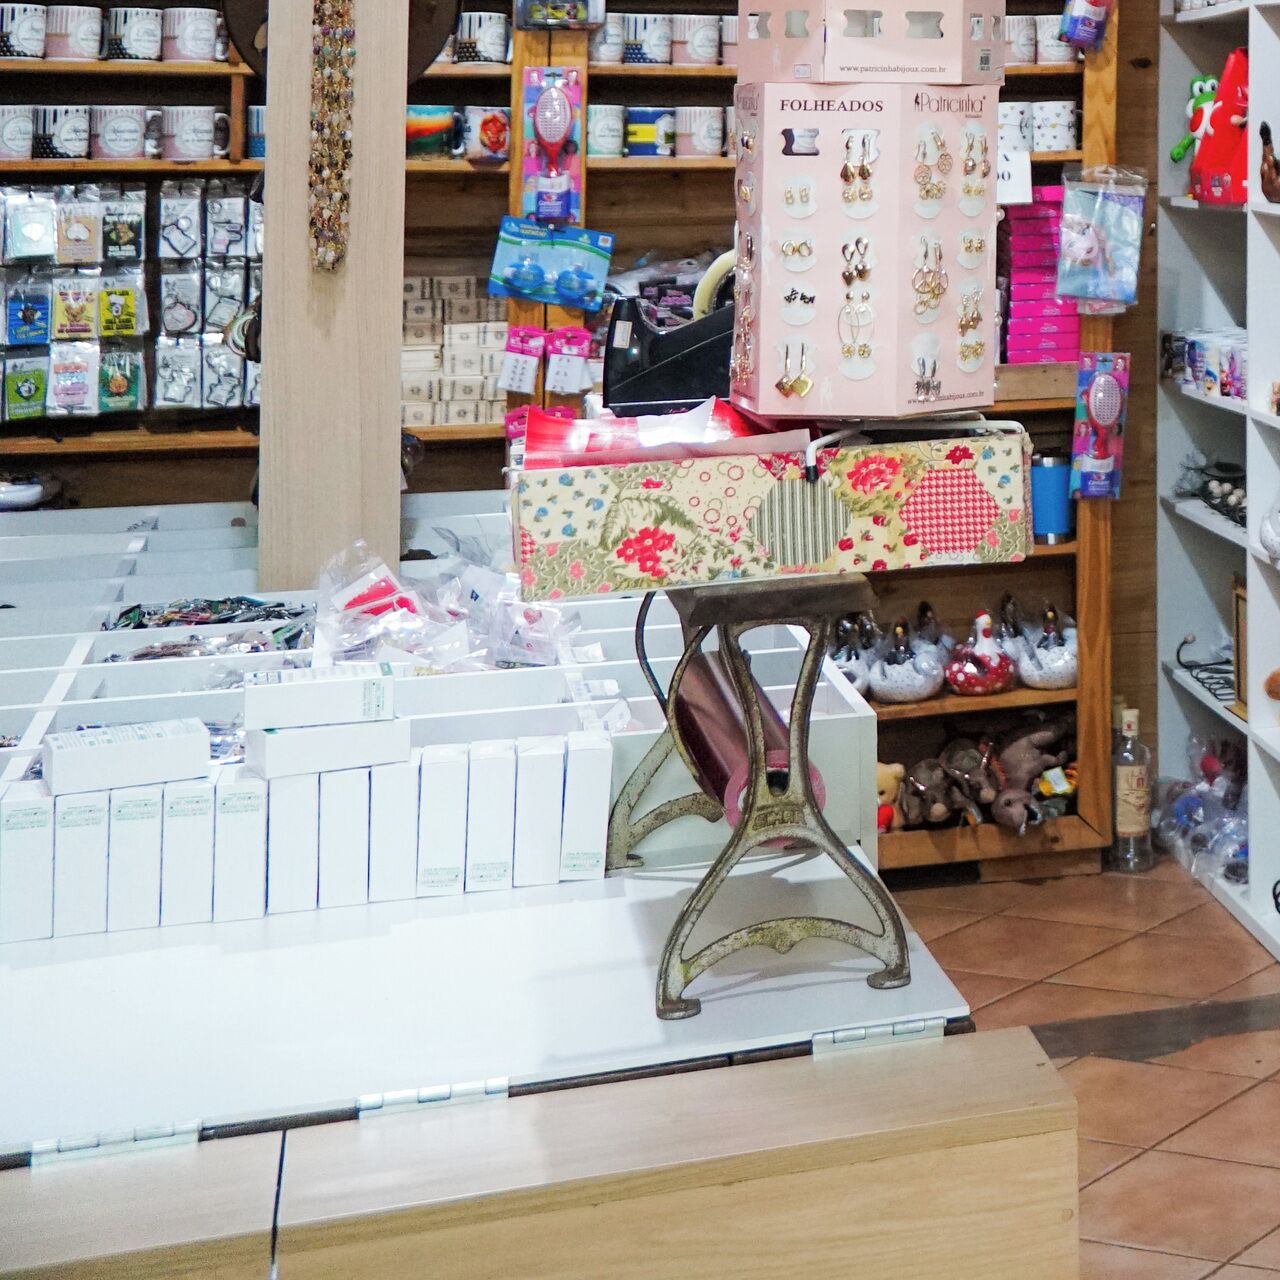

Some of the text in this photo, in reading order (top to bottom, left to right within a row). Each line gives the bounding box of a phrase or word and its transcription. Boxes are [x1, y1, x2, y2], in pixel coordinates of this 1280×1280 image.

[840, 64, 946, 73] www.patricinhabijoux.com.br
[780, 100, 884, 112] FOLHEADOS
[921, 94, 982, 112] Patricinha
